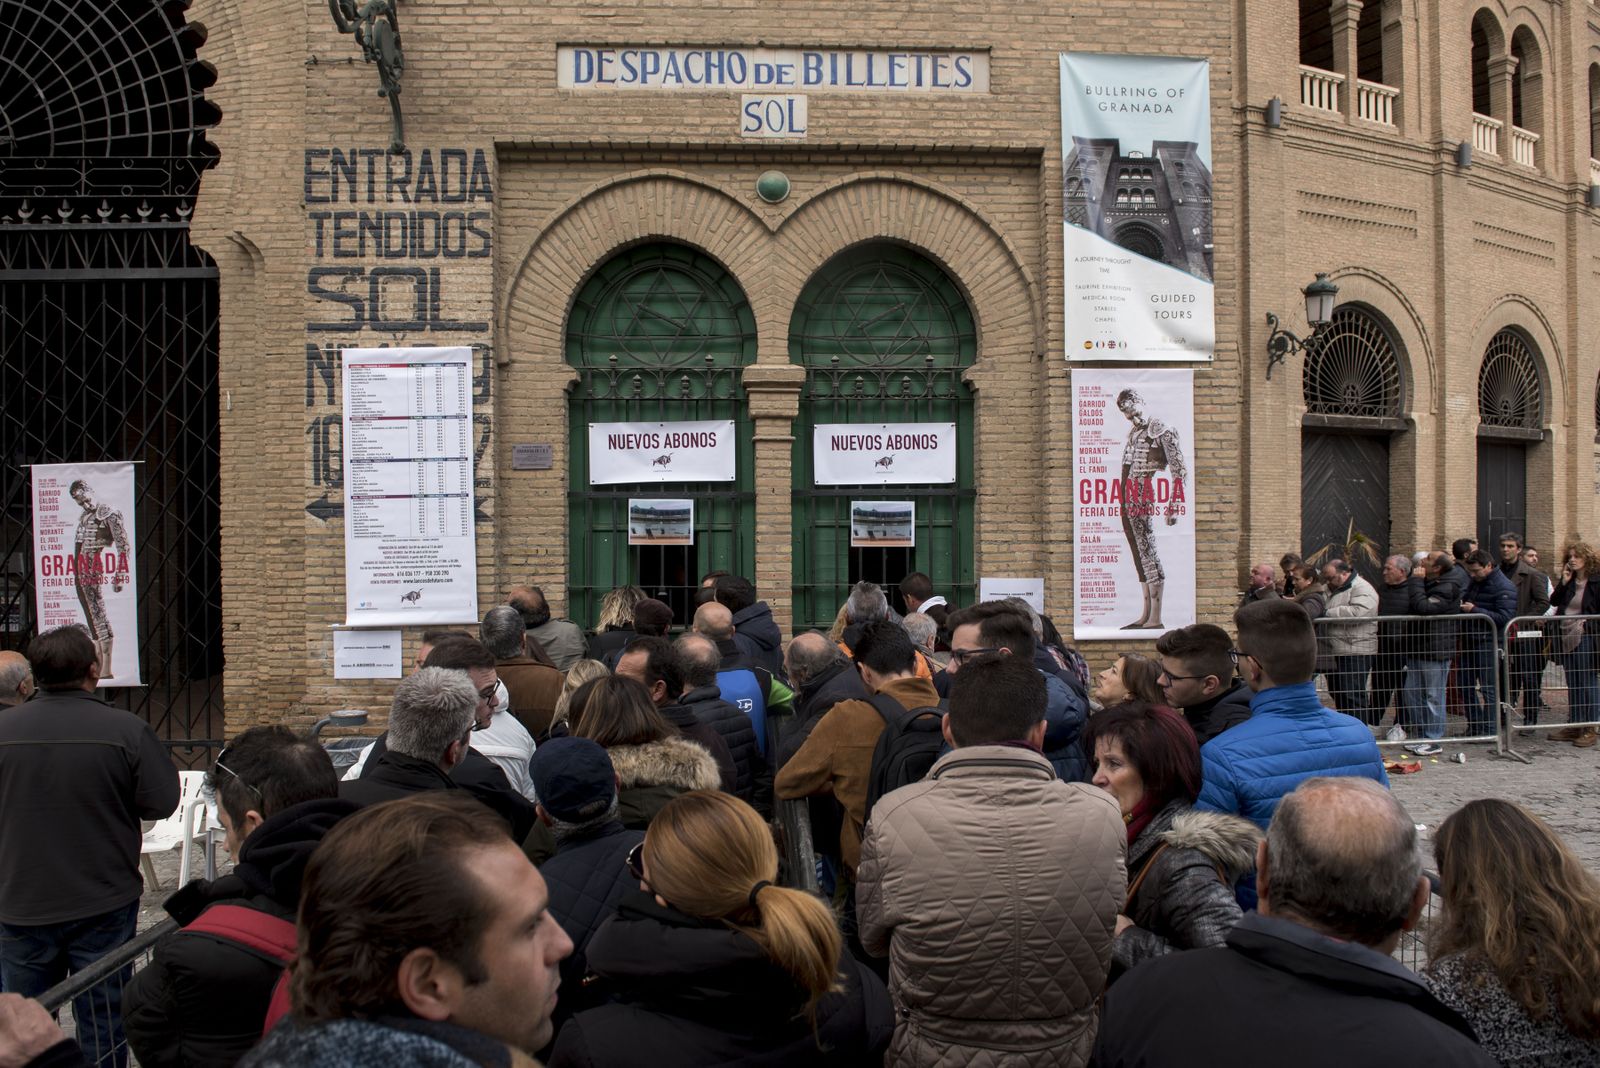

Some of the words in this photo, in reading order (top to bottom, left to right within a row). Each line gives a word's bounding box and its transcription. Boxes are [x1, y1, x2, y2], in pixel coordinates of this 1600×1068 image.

[573, 49, 748, 84] DESPACHO
[754, 63, 796, 85] DE
[802, 53, 973, 88] BILLETES
[1085, 85, 1158, 98] BULLRING
[1166, 88, 1185, 98] OF
[1098, 101, 1174, 113] GRANADA
[744, 98, 807, 133] SOL
[304, 148, 494, 204] ENTRADA
[308, 211, 492, 259] TENDIDOS
[307, 266, 490, 331] SOL
[1150, 294, 1196, 303] GUIDED
[1154, 310, 1193, 319] TOURS
[1078, 400, 1106, 408] GARRIDO
[1079, 418, 1104, 426] AGUADO
[608, 433, 660, 450] NUEVOS
[664, 431, 717, 449] ABONOS
[831, 434, 882, 451] NUEVOS
[886, 434, 938, 450] ABONOS
[1079, 466, 1088, 474] EL
[1079, 477, 1186, 505] GRANADA
[1080, 507, 1105, 517] FERIA
[1163, 505, 1186, 516] 2019
[41, 552, 130, 577] GRANADA
[42, 578, 63, 588] FERIA
